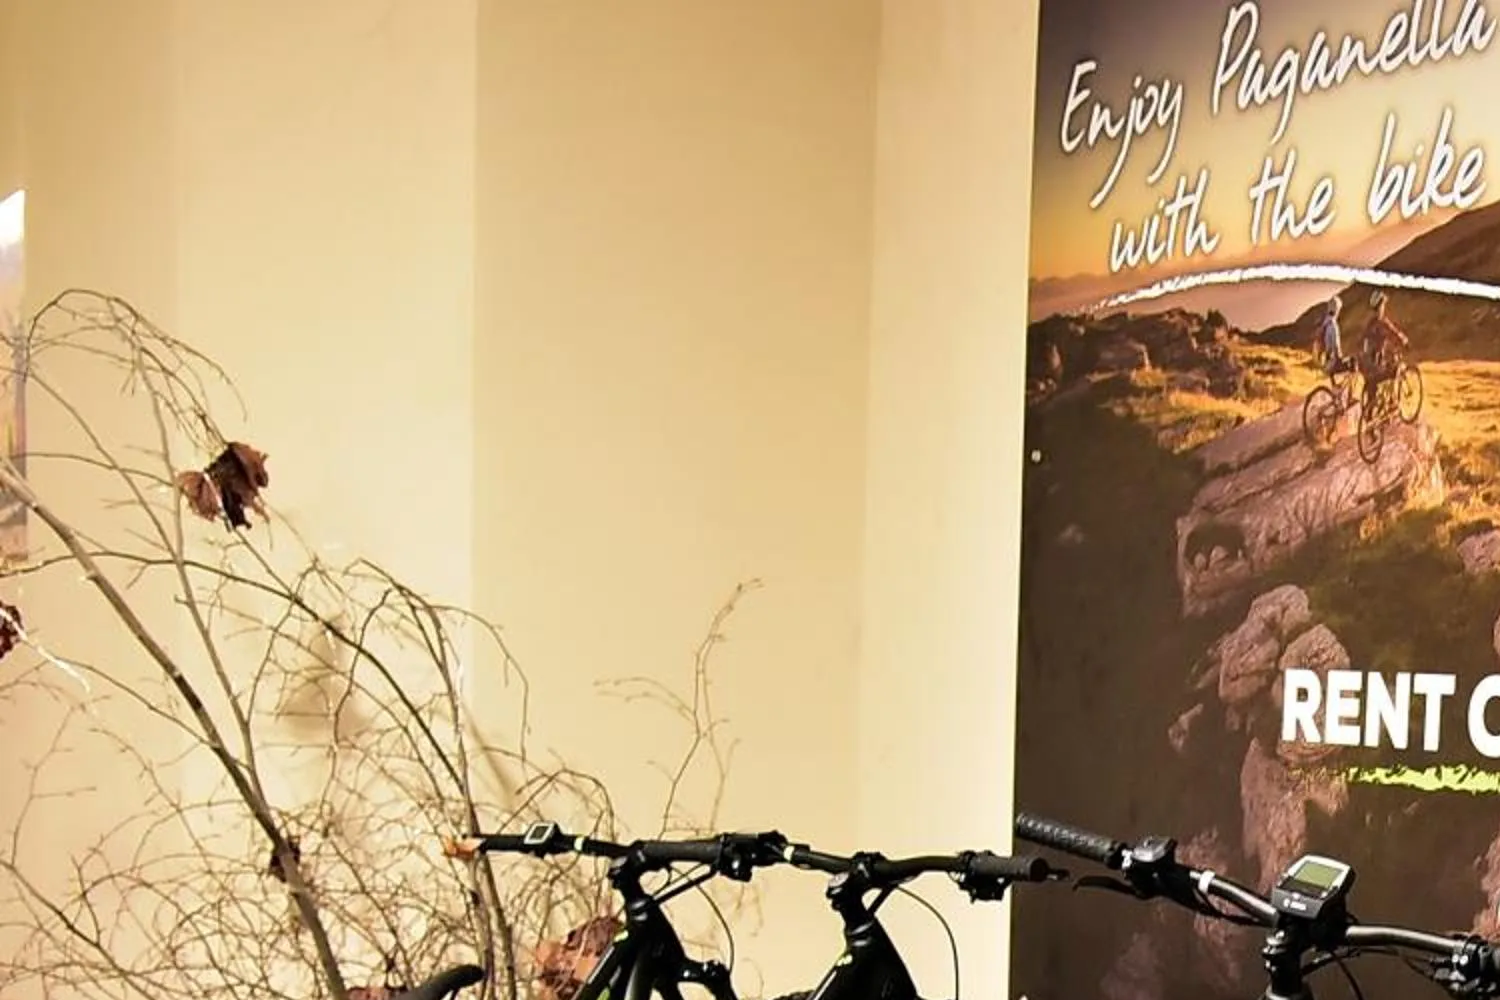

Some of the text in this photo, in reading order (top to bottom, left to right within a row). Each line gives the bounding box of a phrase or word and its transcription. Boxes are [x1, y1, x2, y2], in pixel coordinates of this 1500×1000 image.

[1058, 0, 1500, 210] Enjoy Paganella
[1107, 106, 1488, 274] with the bike
[1281, 668, 1455, 752] RENT
